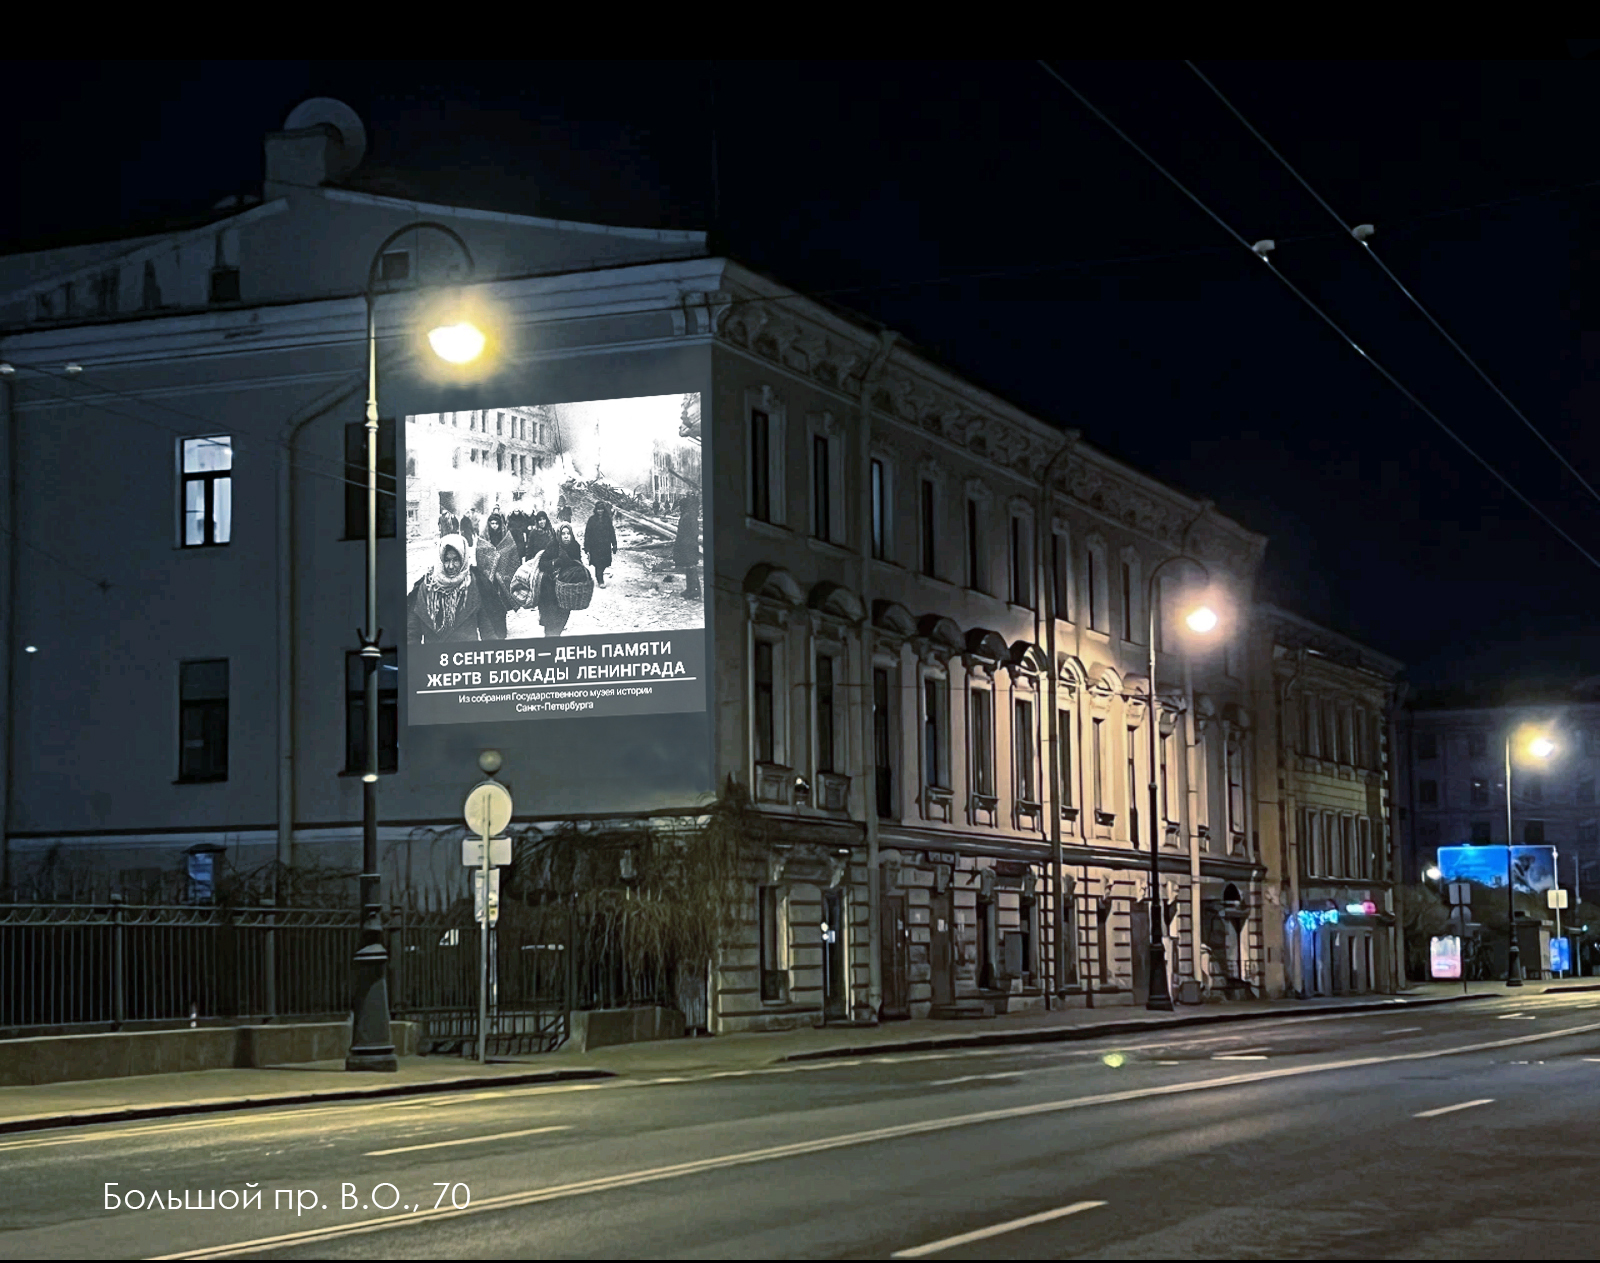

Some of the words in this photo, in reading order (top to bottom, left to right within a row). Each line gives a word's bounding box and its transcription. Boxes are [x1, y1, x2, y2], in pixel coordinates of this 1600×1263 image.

[440, 653, 448, 666] 8
[453, 648, 535, 665] СЕНТЯБРЯ
[554, 645, 597, 663] ДЕНЬ
[601, 641, 671, 658] ПАМЯТИ
[427, 672, 481, 687] ЖЕРТВ
[489, 666, 568, 684] БЛОКАДЫ
[577, 661, 685, 680] ЛЕНИНГРАДА
[459, 695, 470, 703] Из
[471, 694, 511, 704] собрания
[512, 689, 588, 702] Государственного
[590, 688, 615, 698] музея
[617, 686, 652, 696] истории
[516, 701, 594, 713] Санкт-Петербурга
